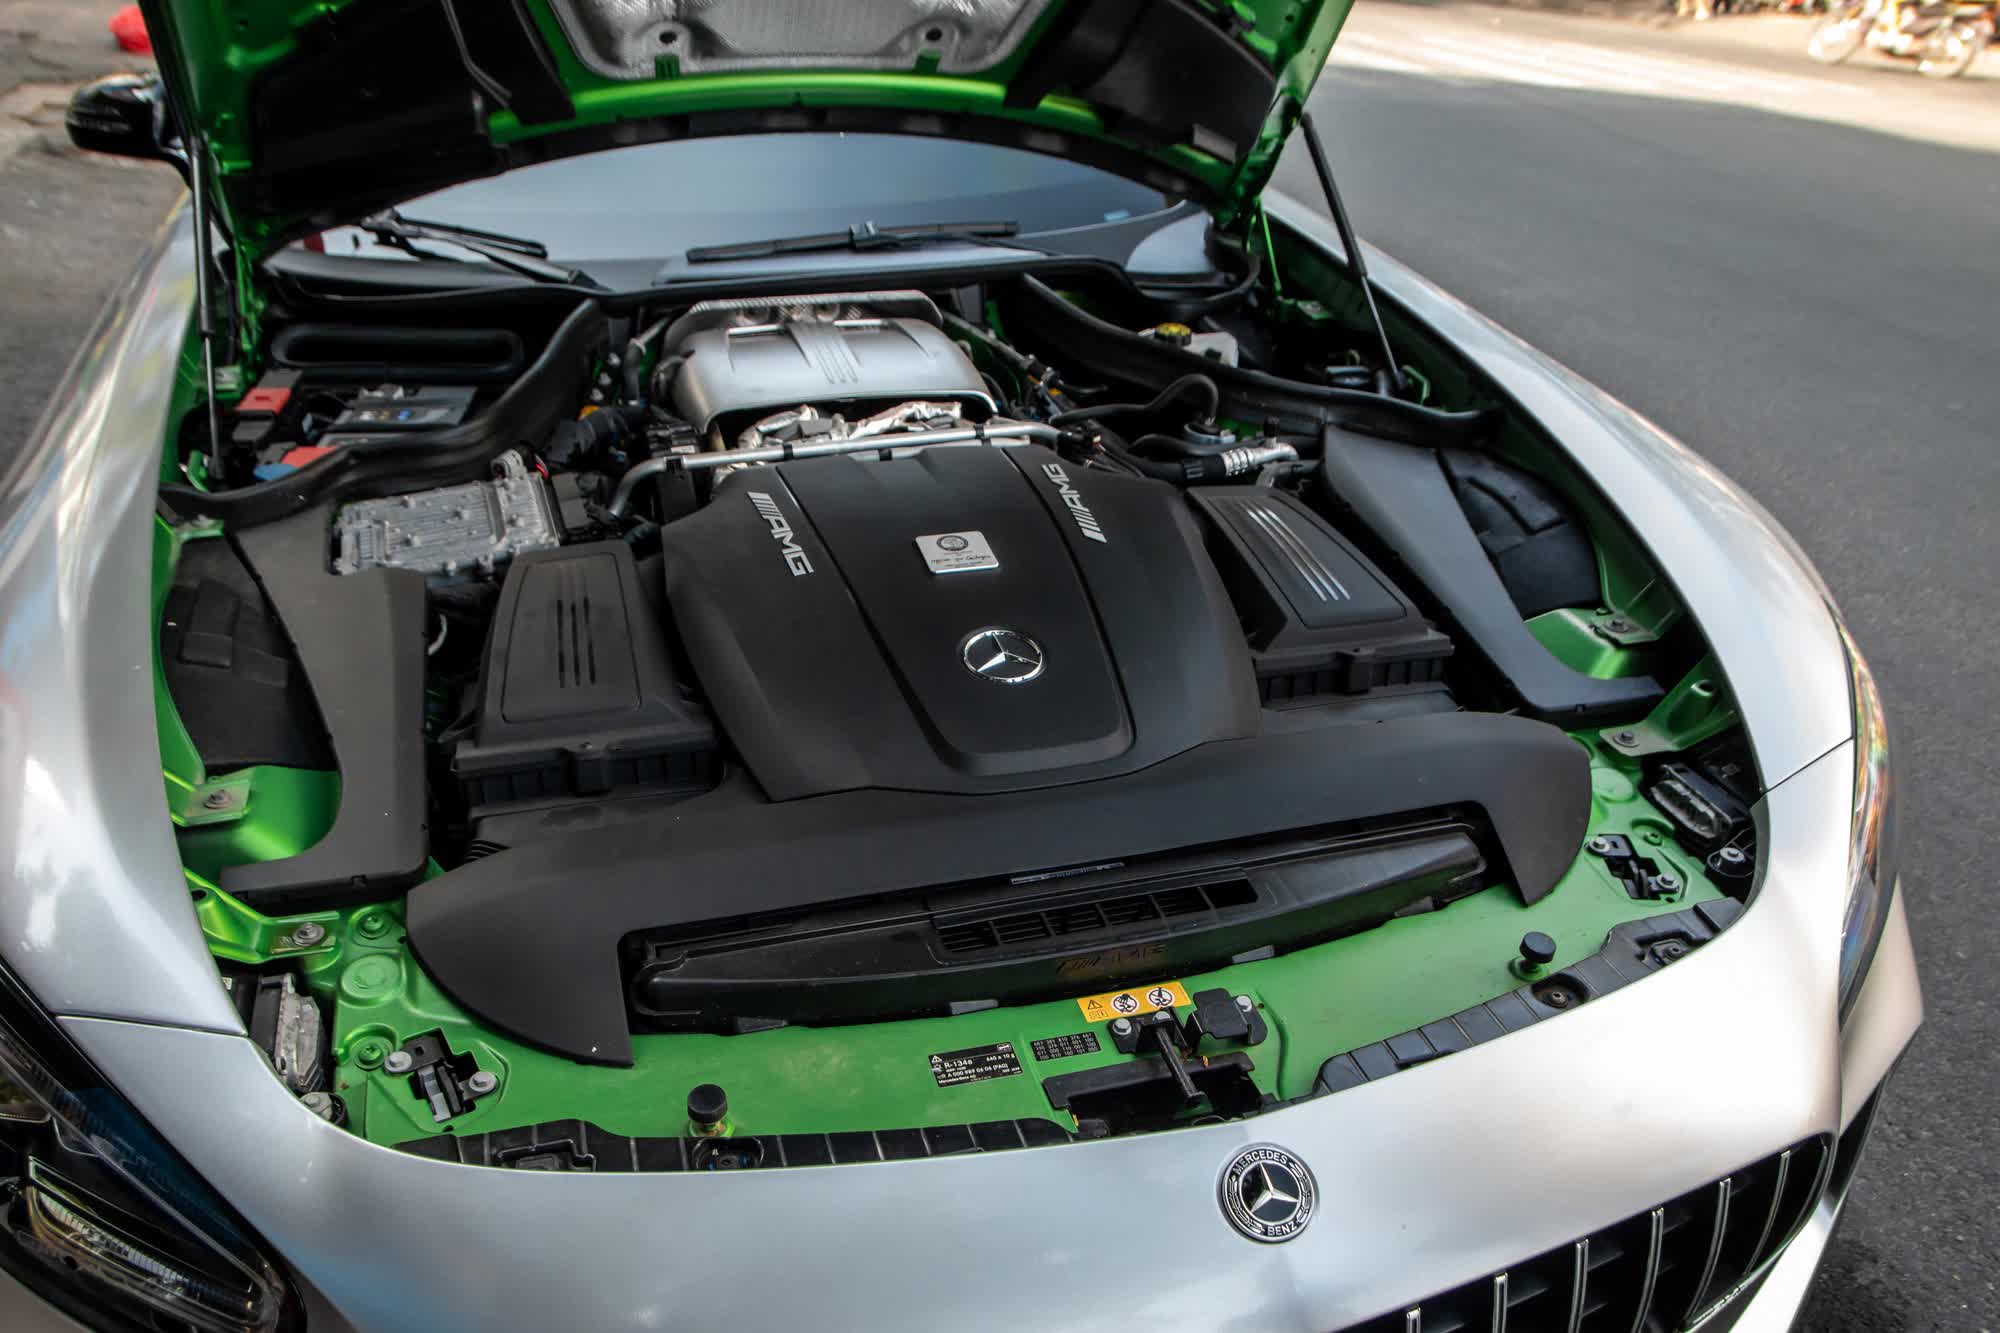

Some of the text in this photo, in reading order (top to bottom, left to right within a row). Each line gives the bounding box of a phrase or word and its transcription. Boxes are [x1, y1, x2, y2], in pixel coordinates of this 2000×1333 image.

[760, 512, 815, 577] AMG
[944, 1060, 972, 1068] R-134a
[1232, 1150, 1288, 1175] MERCEDES
[1267, 1220, 1298, 1236] BENZ
